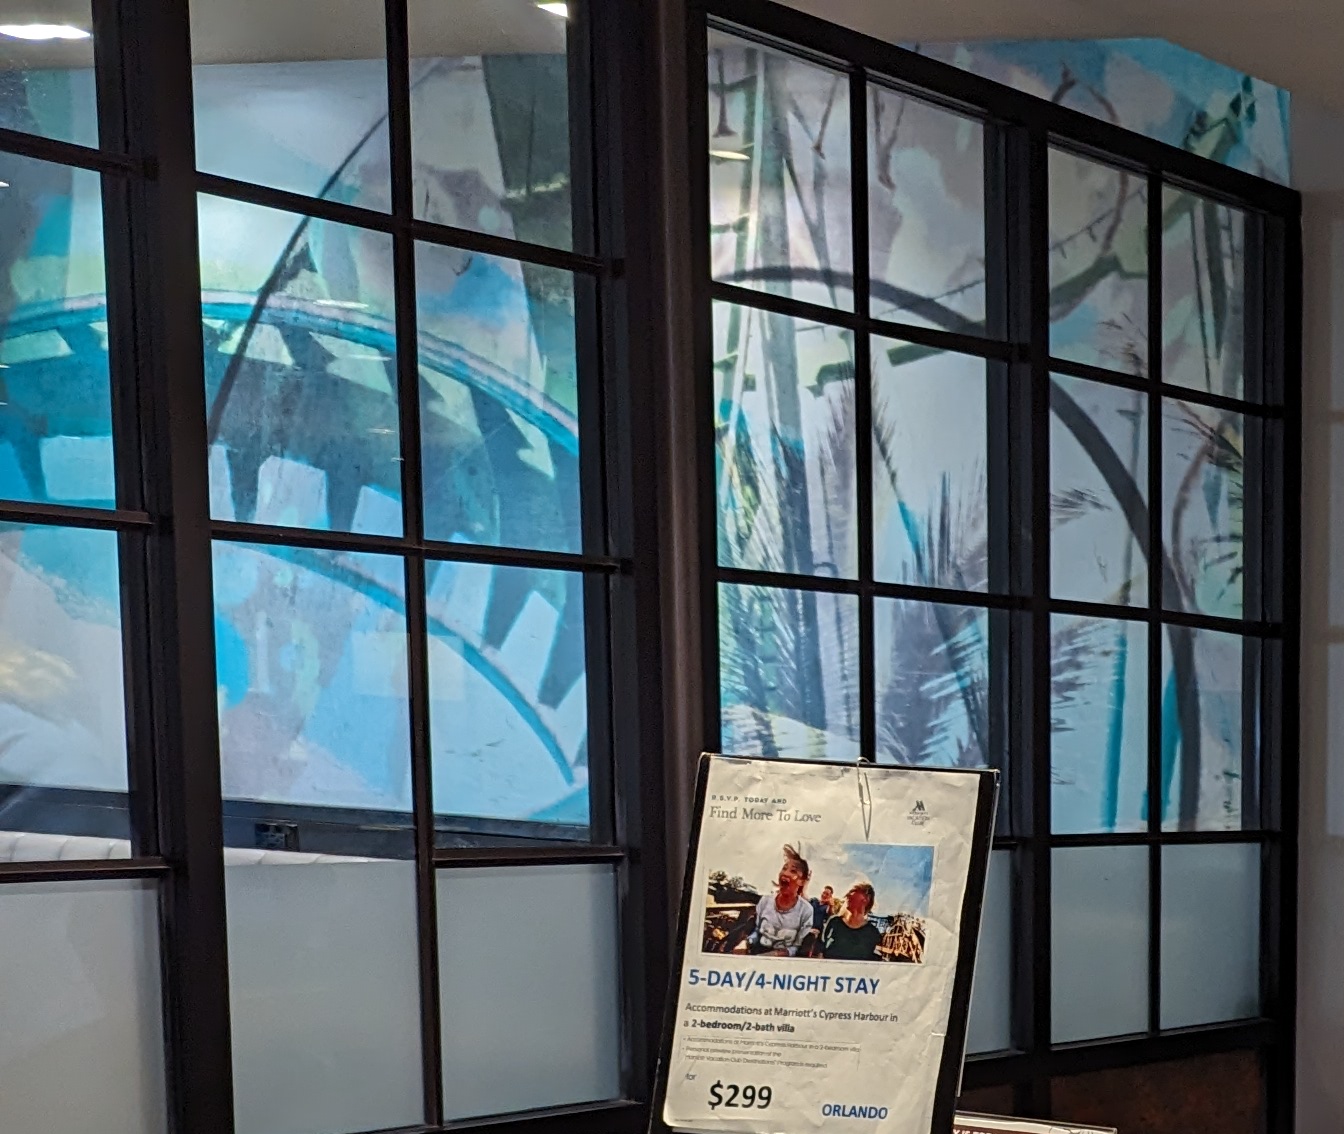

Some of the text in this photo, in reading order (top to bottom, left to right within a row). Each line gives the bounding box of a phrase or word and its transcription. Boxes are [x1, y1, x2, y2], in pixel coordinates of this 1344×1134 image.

[744, 796, 769, 804] TODAY
[771, 797, 787, 805] AND
[709, 805, 822, 823] Find More To Love
[688, 969, 880, 995] 5-DAY/4-NIGHT STAY
[685, 1003, 898, 1022] Accommodations at Marriott's Cypress Harbour in
[691, 1019, 775, 1032] 2-bedroom/2-bath
[776, 1023, 795, 1033] villa
[685, 1073, 697, 1081] for
[708, 1080, 773, 1110] $299
[822, 1104, 888, 1120] ORLANDO
